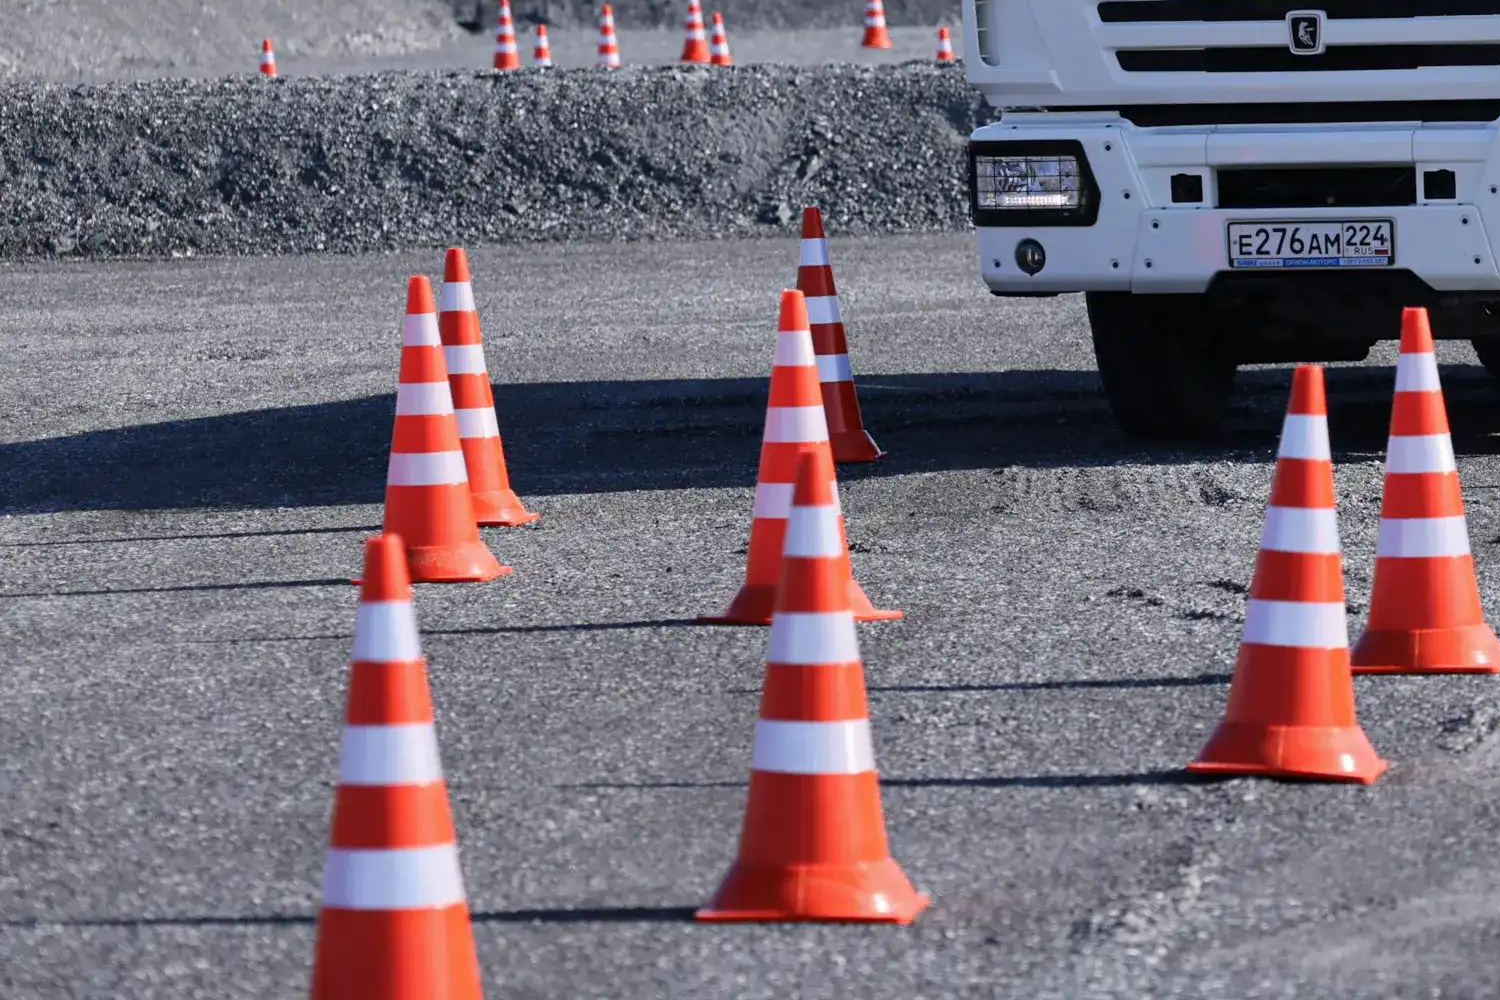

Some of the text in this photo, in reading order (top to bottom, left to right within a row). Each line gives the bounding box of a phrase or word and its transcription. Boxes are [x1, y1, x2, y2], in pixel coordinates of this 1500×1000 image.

[1238, 225, 1386, 256] E276AM 224
[1354, 247, 1374, 255] RUS
